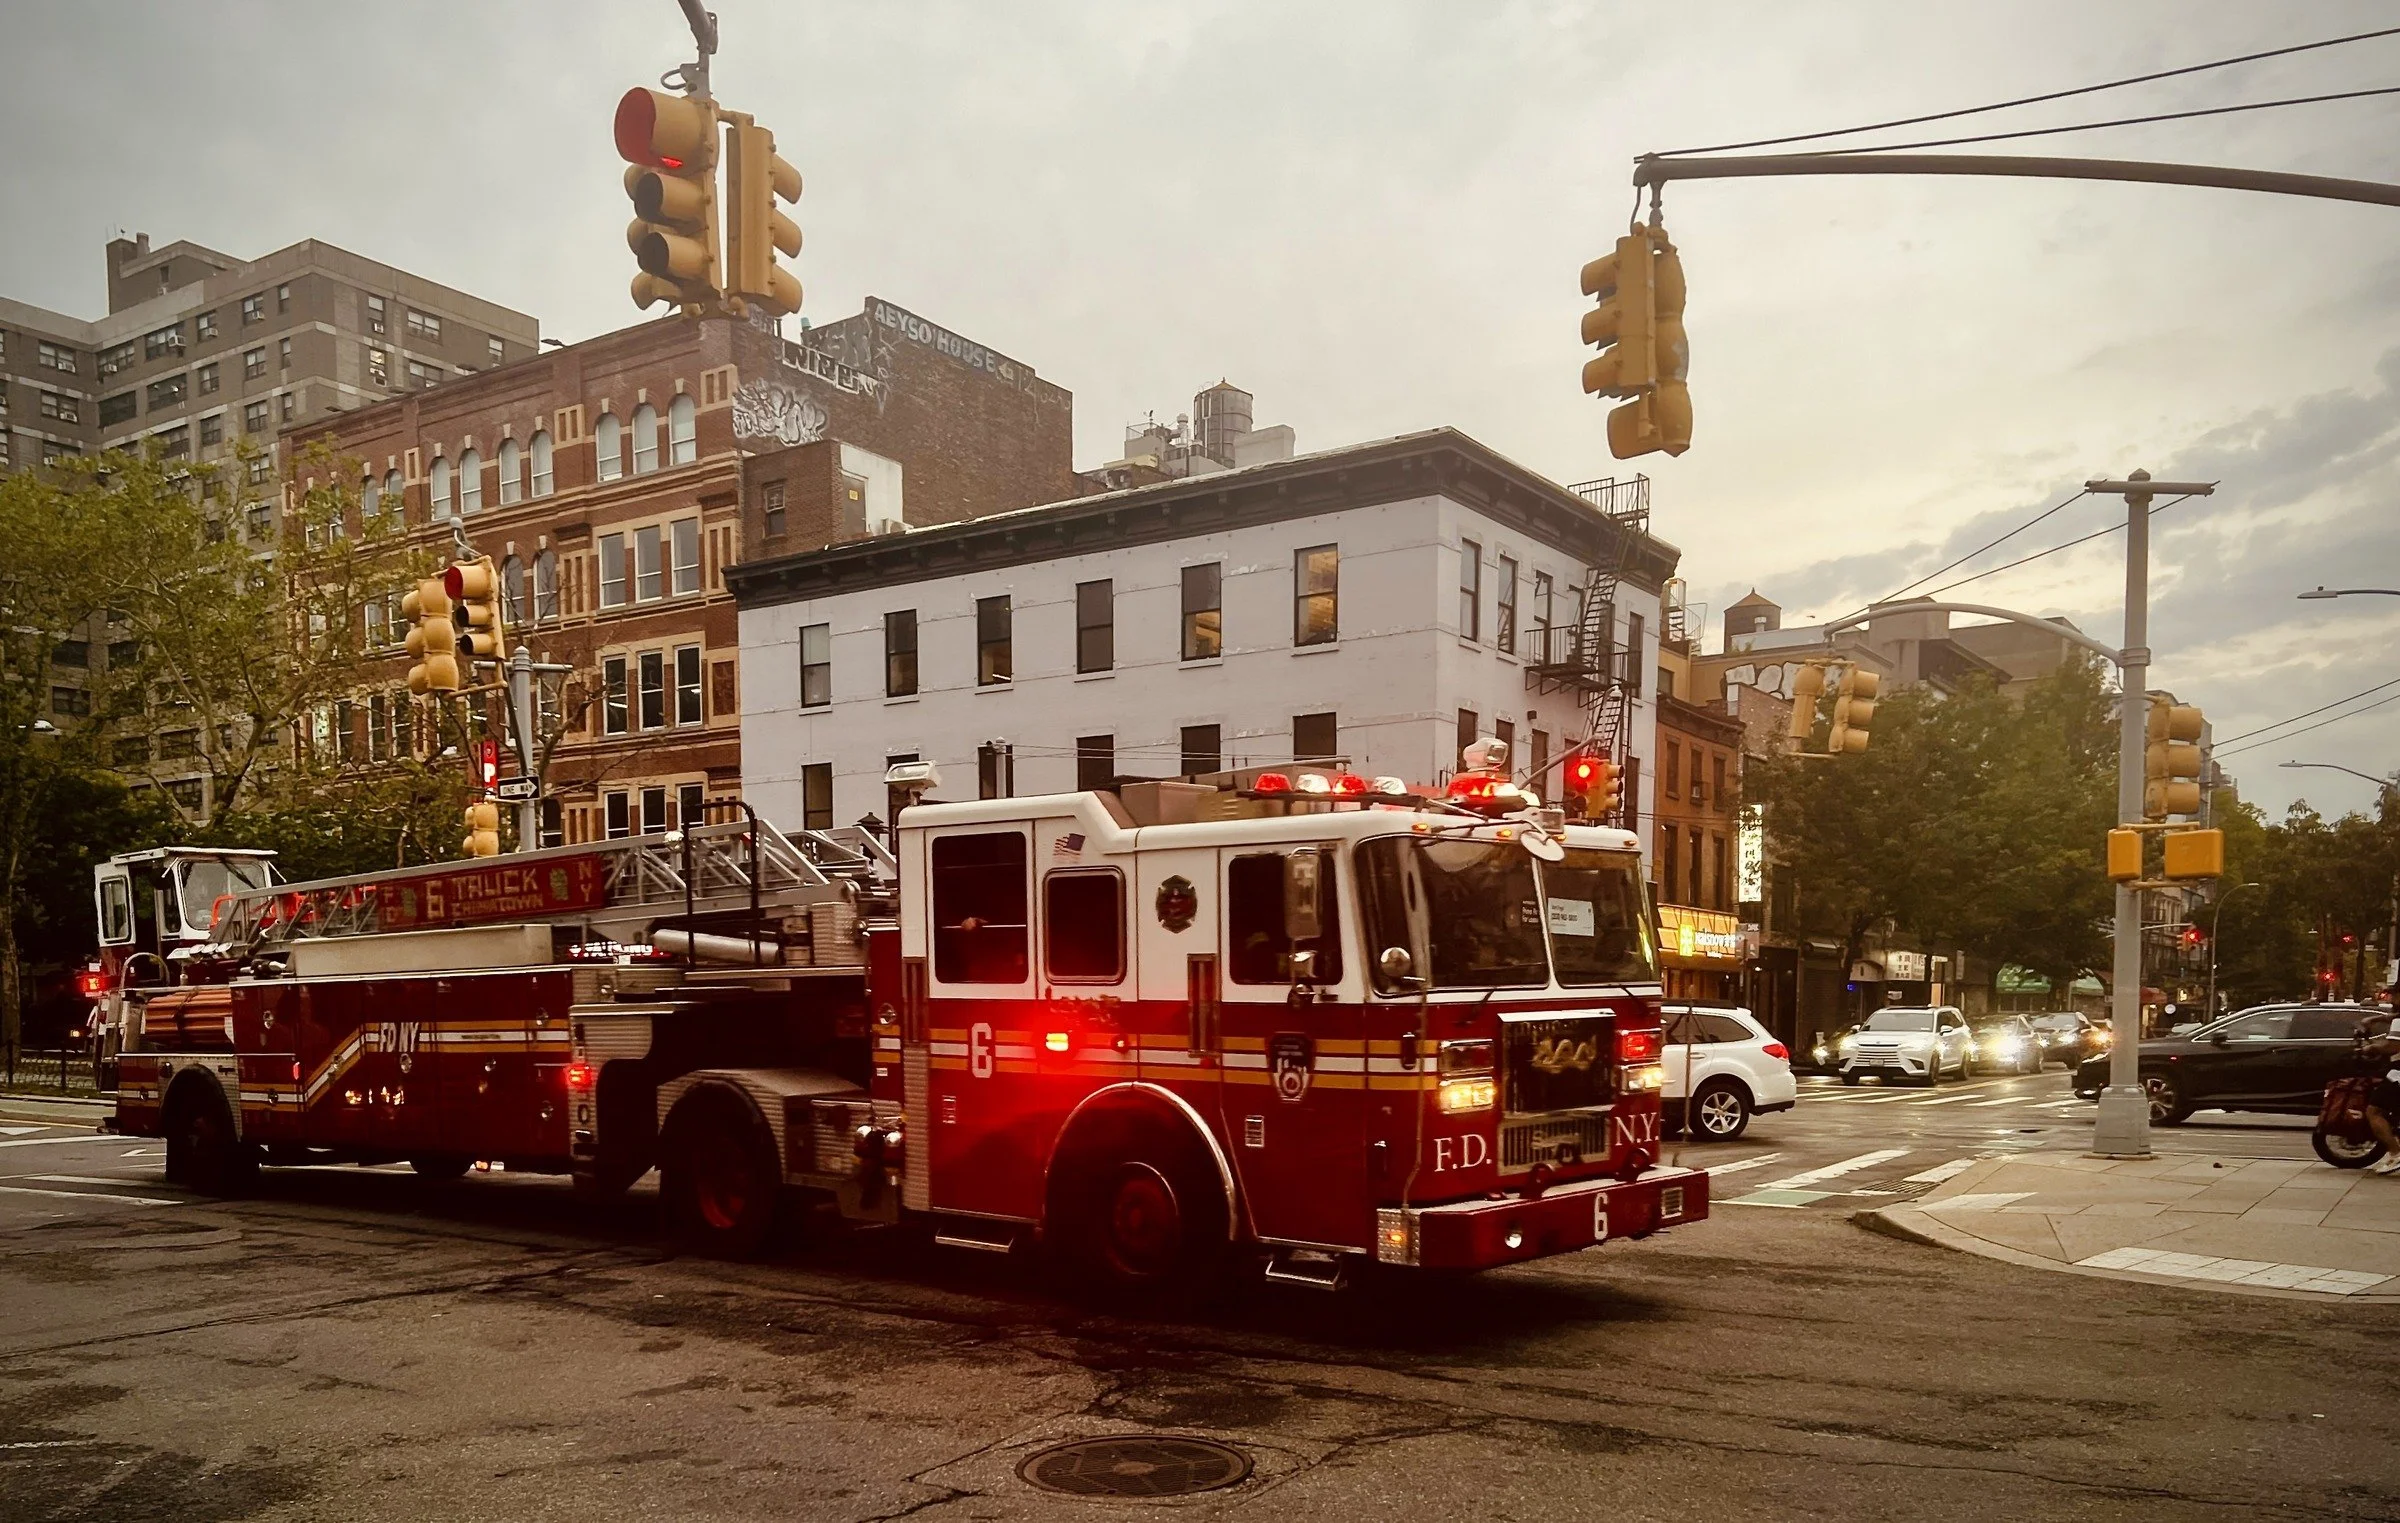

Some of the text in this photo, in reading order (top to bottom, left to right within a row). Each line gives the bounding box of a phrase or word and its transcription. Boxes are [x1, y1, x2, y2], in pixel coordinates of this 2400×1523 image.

[874, 302, 997, 373] AEYSO HOUSE
[424, 879, 445, 920] 6
[451, 867, 539, 900] TRUCK
[451, 893, 544, 917] CHINATOWN
[971, 1022, 993, 1079] 6
[1614, 1111, 1660, 1146] N.Y.
[1433, 1133, 1493, 1173] F.D.
[1593, 1191, 1609, 1240] 6
